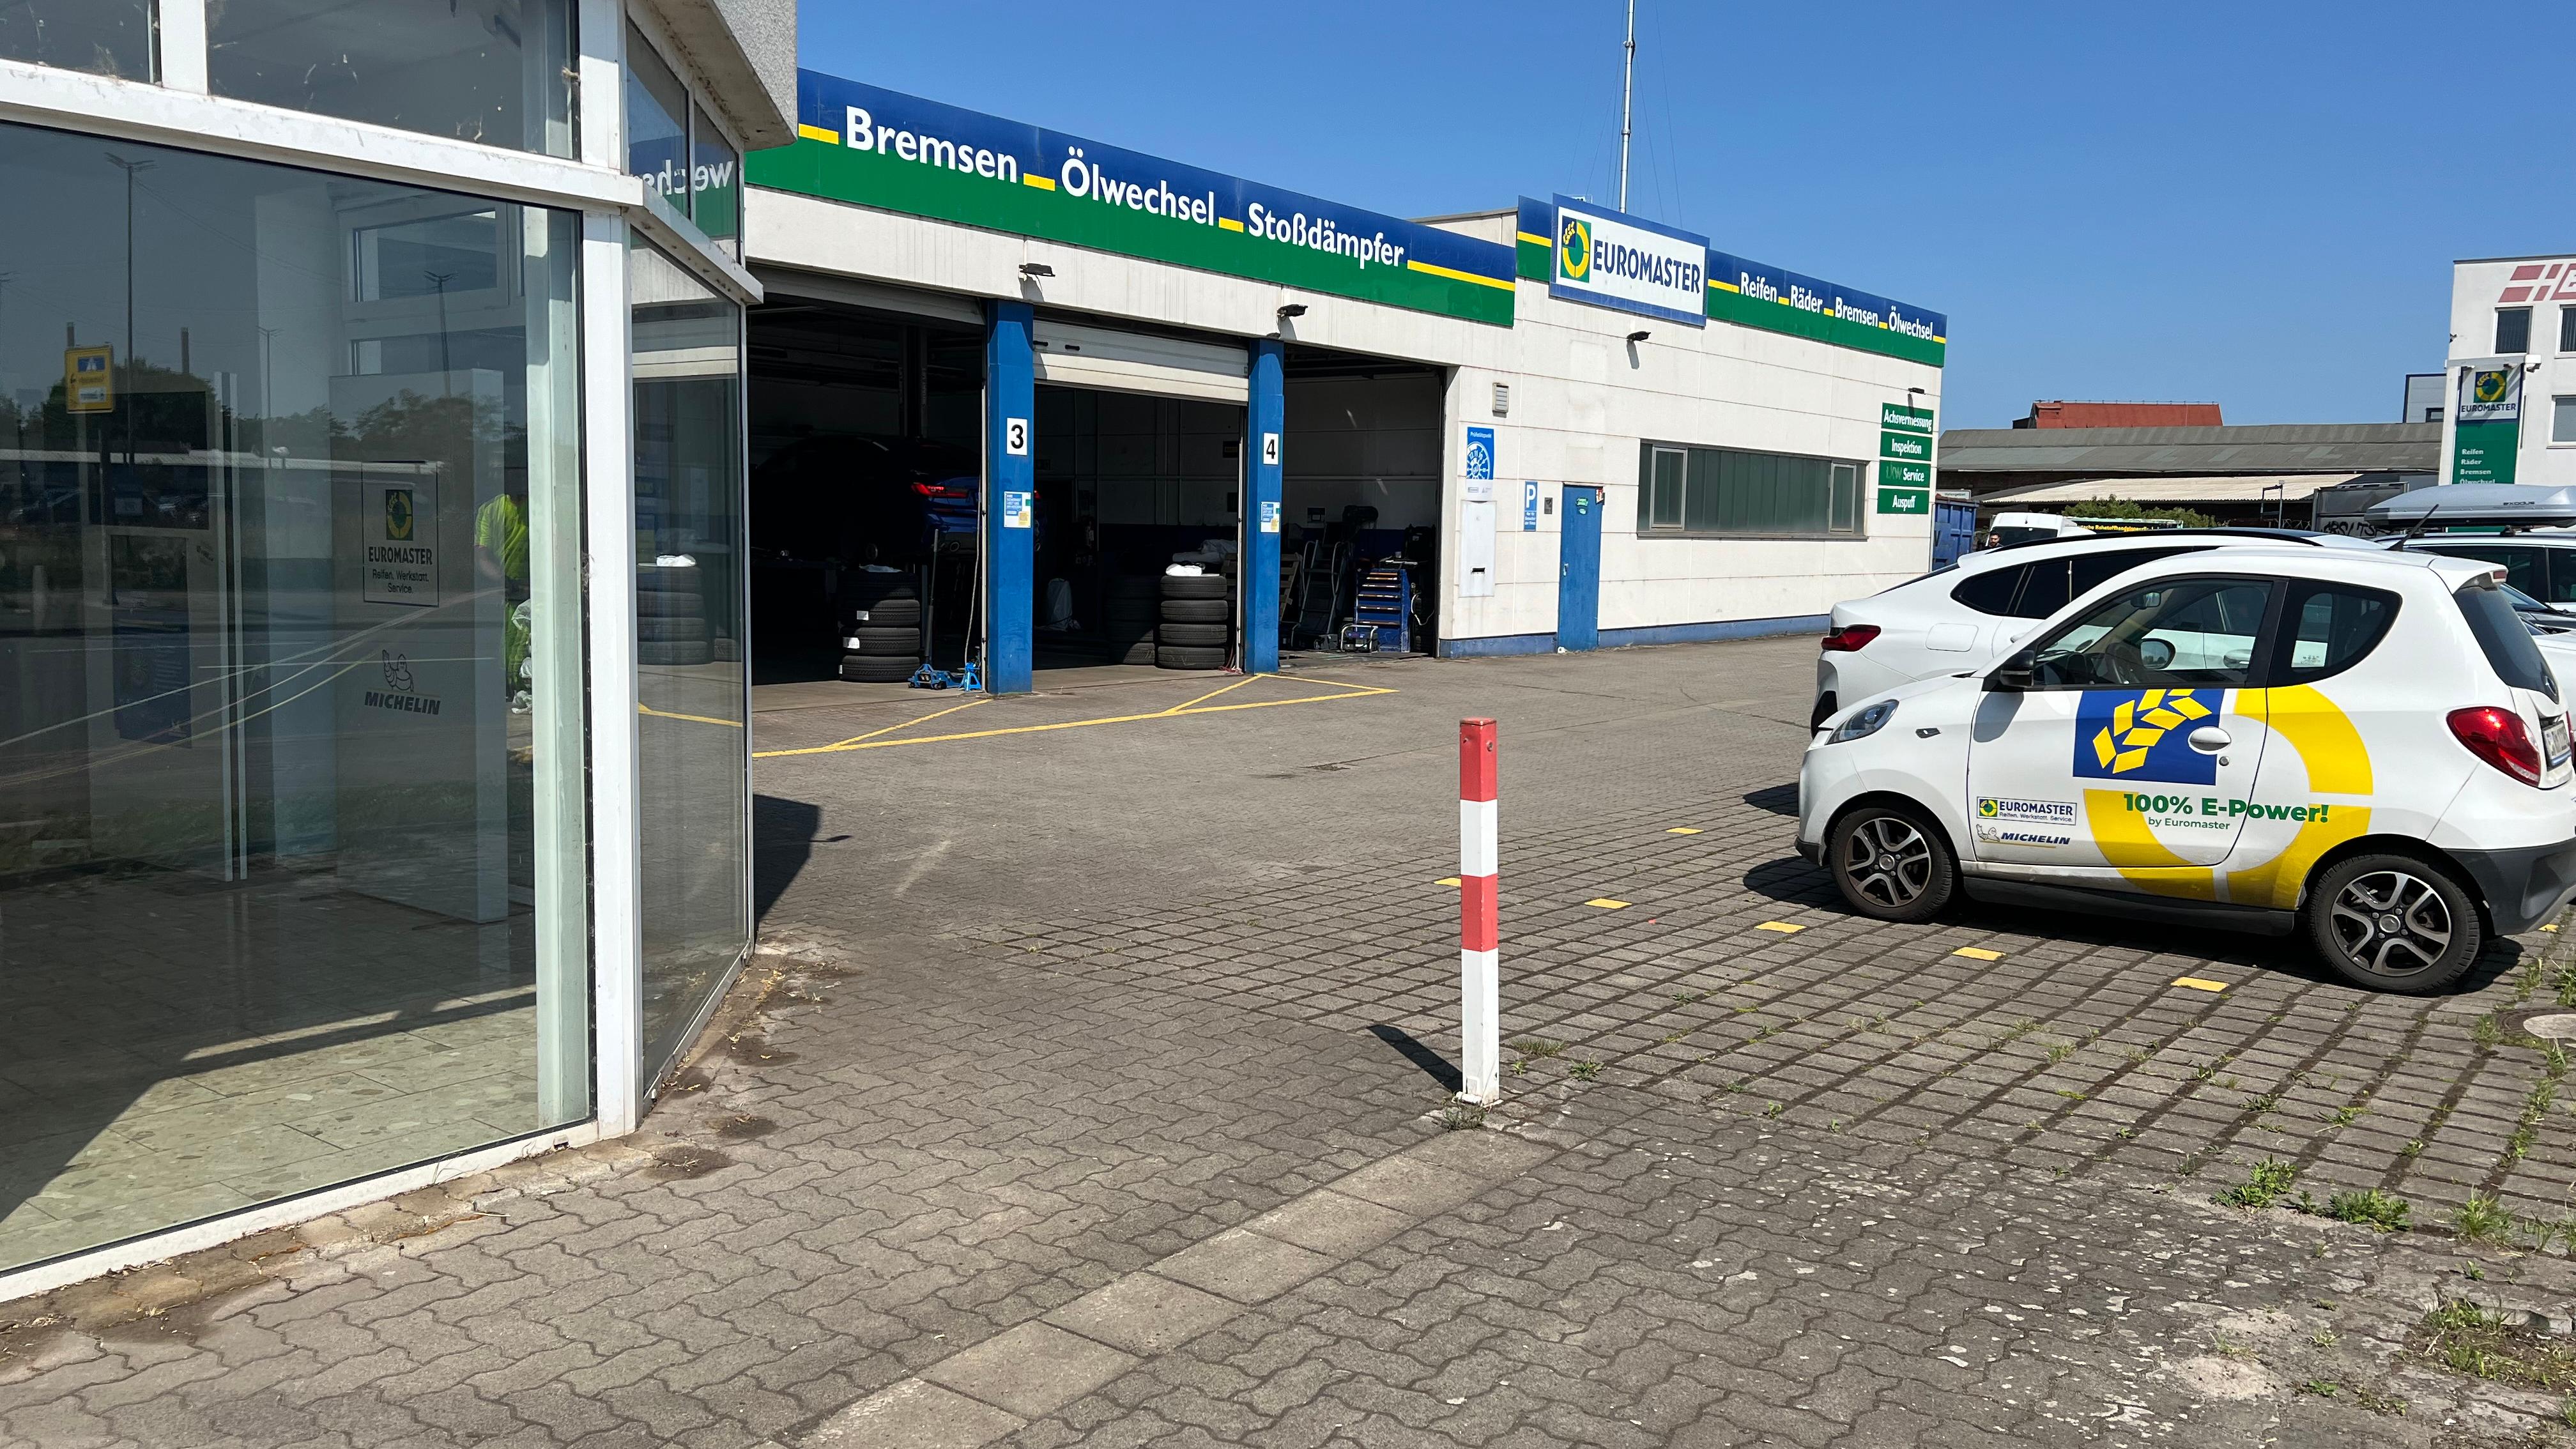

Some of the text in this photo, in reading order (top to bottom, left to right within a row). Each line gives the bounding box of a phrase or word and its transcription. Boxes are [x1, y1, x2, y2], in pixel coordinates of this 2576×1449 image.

[847, 105, 1404, 269] Bremsen Ölwechsel Stoßdämpfer
[1593, 239, 1700, 294] EUROMASTER
[1740, 272, 1933, 341] Reifen Räder Bremsen Ölwechsel
[2461, 403, 2516, 412] EUROMASTER
[1883, 409, 1932, 432] Achsvermessung
[1010, 424, 1023, 449] 3
[1266, 439, 1275, 459] 4
[1892, 438, 1922, 456] Inspektion
[1903, 468, 1925, 482] Service
[1526, 484, 1537, 509] P
[1892, 495, 1917, 512] Auspuff
[368, 546, 433, 565] EUROMASTER
[372, 569, 429, 582] Reifen. Werkstatt.
[388, 583, 413, 594] Service.
[365, 691, 441, 715] MICHELIN
[1999, 801, 2073, 816] EUROMASTER
[2124, 793, 2329, 824] 100% E-Power!
[2148, 816, 2230, 830] by Euromaster
[2001, 832, 2071, 845] MICHELIN
